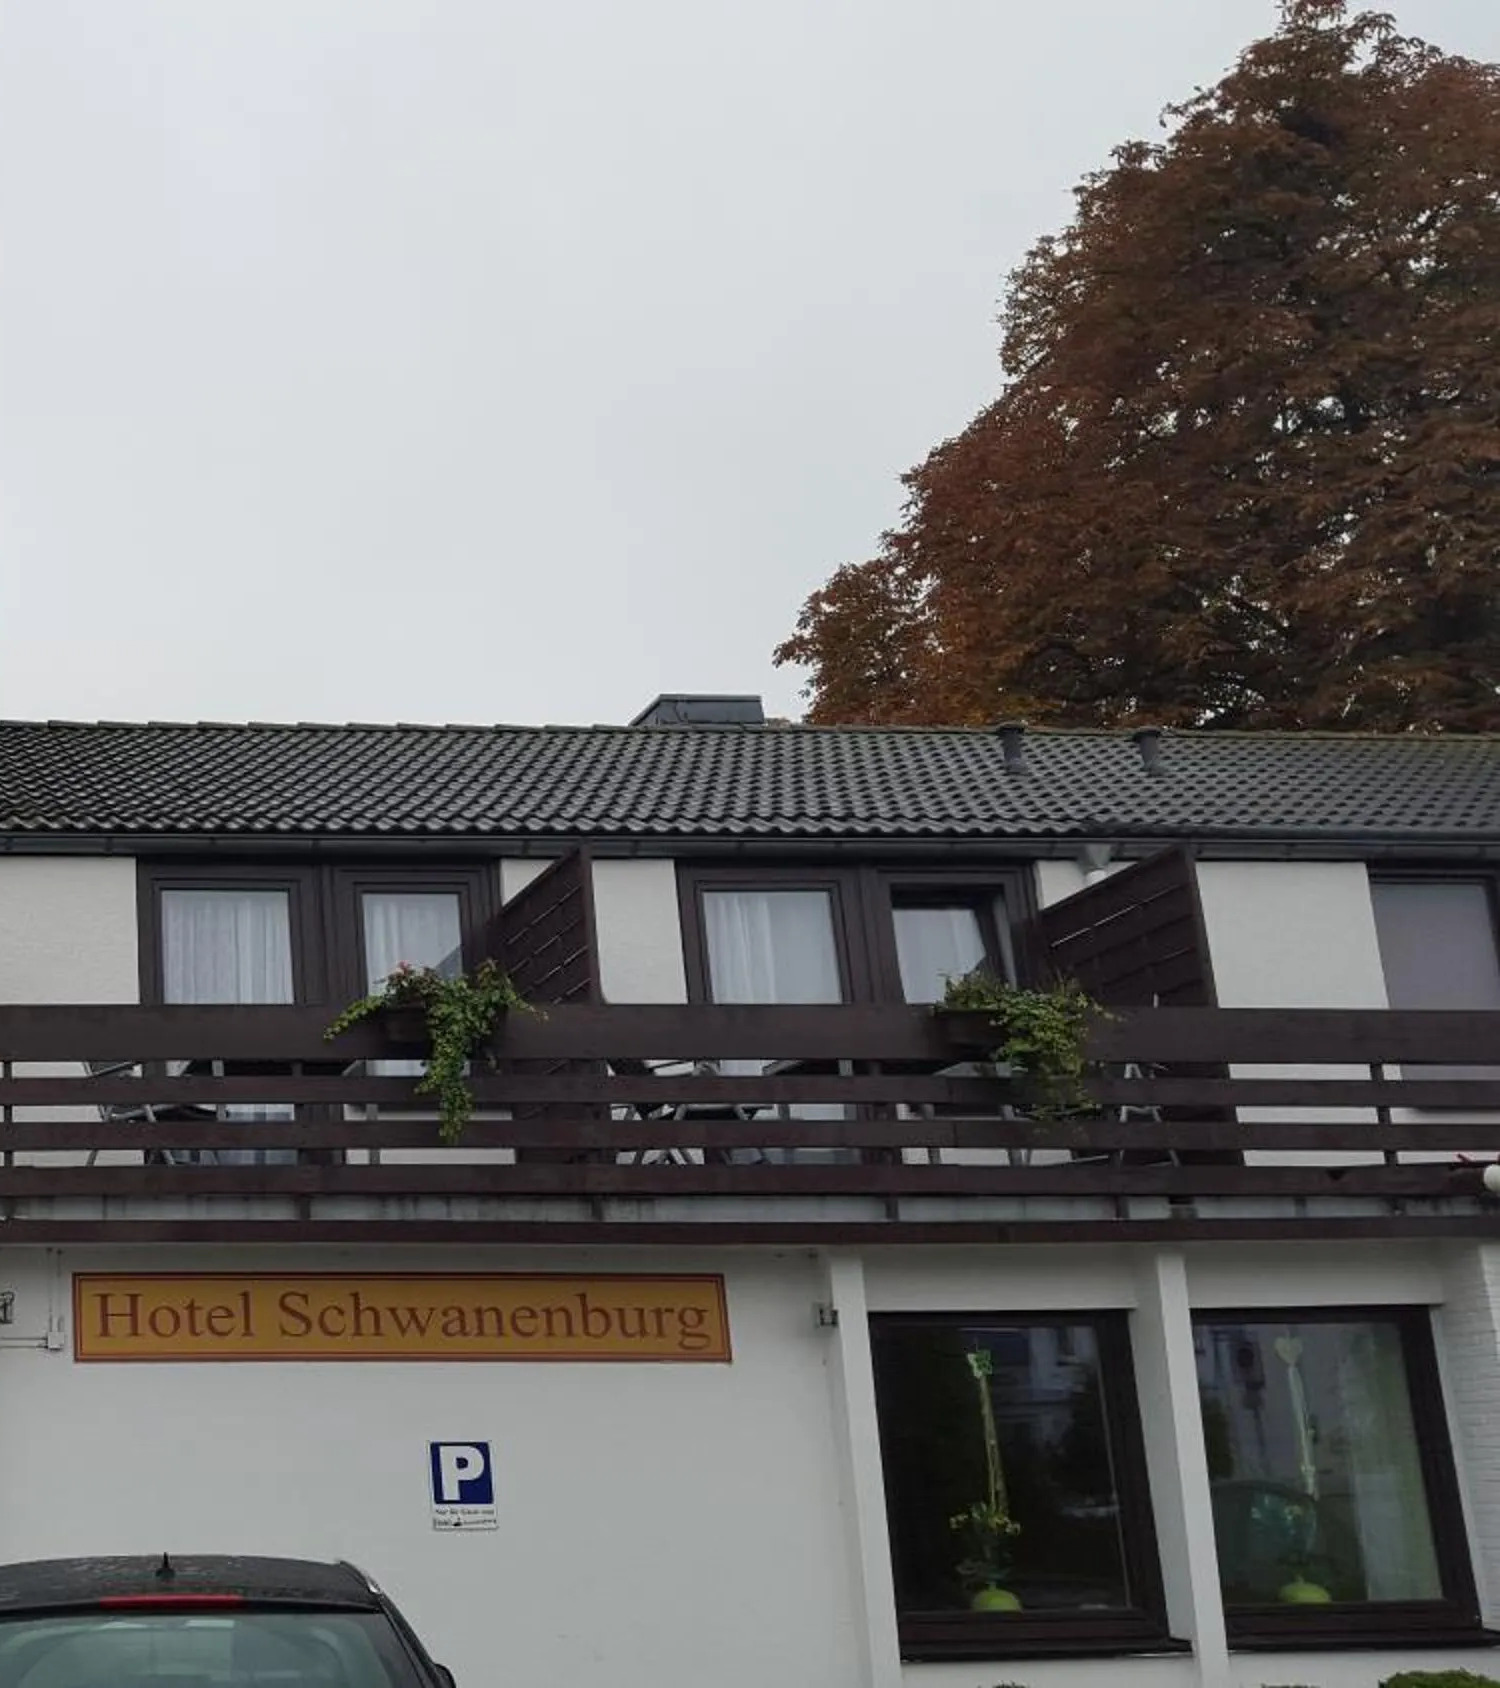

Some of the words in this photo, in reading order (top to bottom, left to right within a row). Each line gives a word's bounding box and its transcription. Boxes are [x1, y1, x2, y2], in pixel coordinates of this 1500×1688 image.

[93, 1290, 255, 1338] Hotel
[278, 1291, 712, 1351] Schwanenburg
[440, 1445, 485, 1500] P
